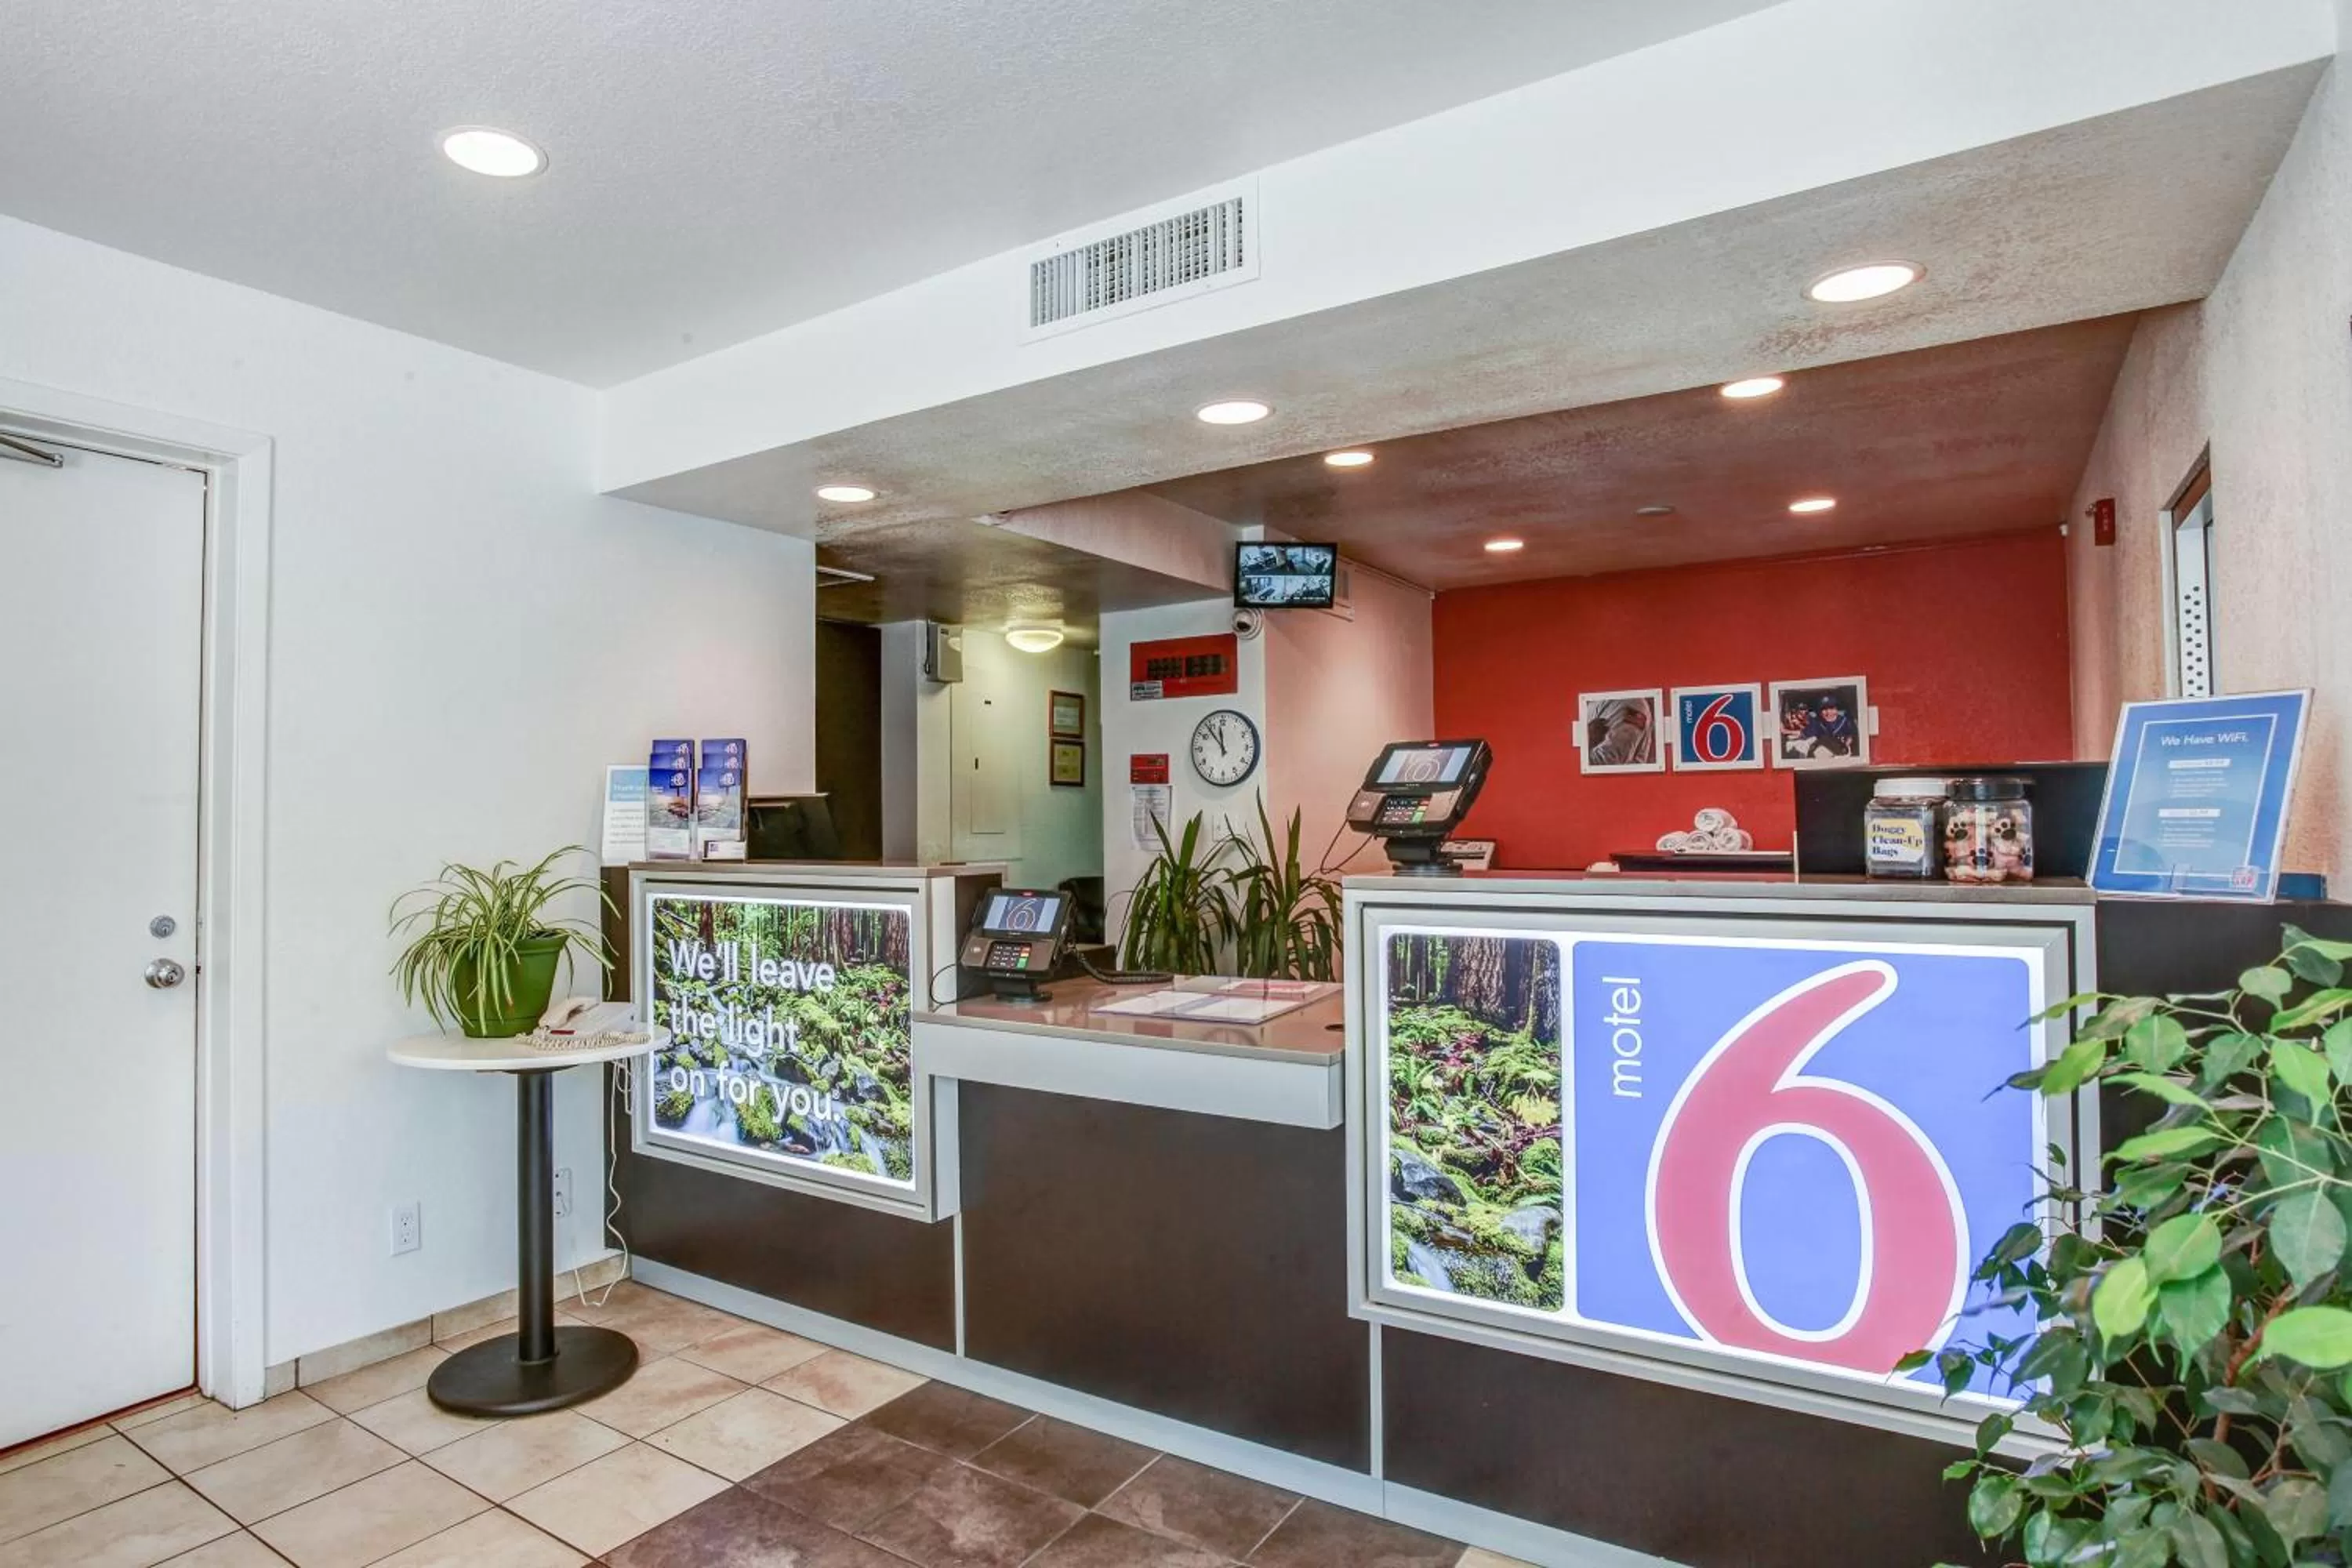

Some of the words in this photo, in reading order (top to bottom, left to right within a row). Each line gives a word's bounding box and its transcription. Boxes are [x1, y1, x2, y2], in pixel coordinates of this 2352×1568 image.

[1683, 700, 1693, 724] motel
[1693, 694, 1745, 764] 6
[2160, 735, 2181, 746] We
[2183, 734, 2215, 745] Have
[1872, 836, 1923, 847] Clean-Up
[1873, 846, 1898, 857] Bags
[1006, 898, 1037, 929] 6
[668, 939, 738, 982] We'll
[751, 943, 836, 993] leave
[670, 995, 716, 1039] the
[728, 1001, 799, 1058] light
[670, 1065, 705, 1098] on
[717, 1060, 762, 1106] for
[1602, 976, 1642, 1098] motel
[1645, 959, 1971, 1378] 6
